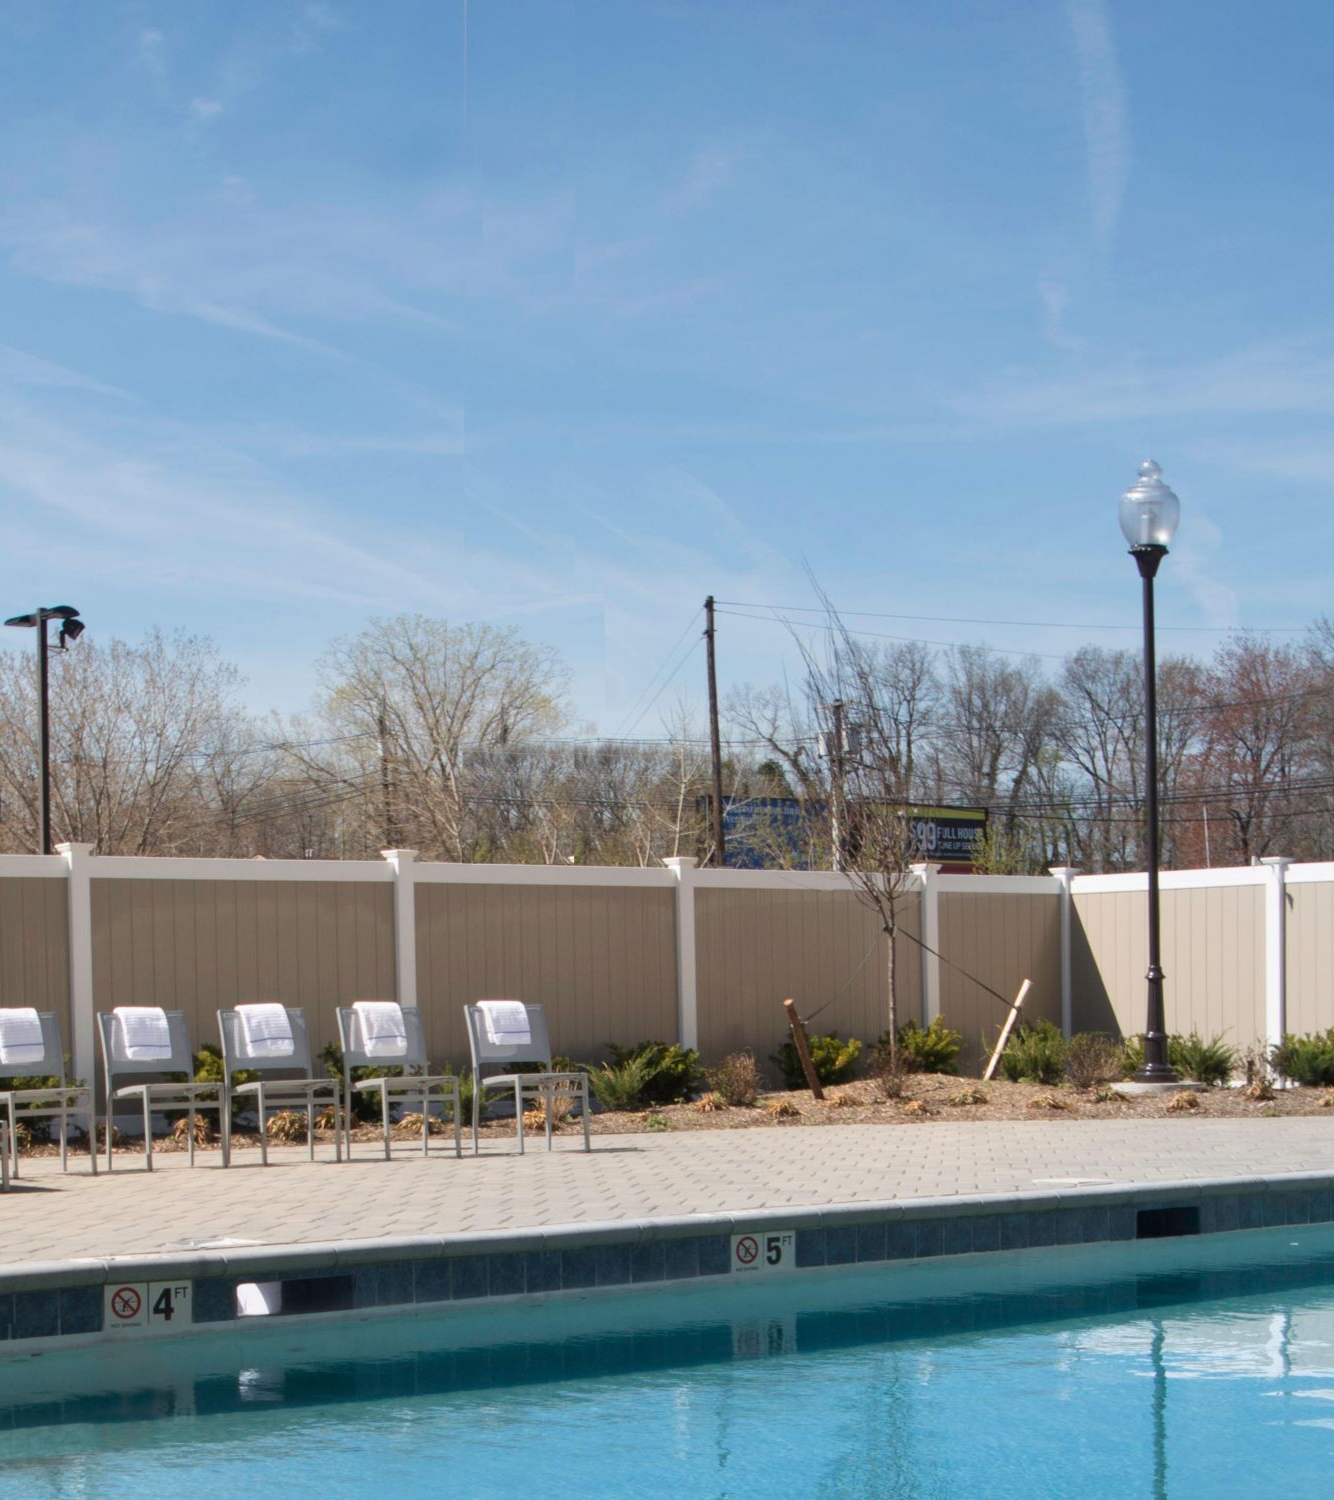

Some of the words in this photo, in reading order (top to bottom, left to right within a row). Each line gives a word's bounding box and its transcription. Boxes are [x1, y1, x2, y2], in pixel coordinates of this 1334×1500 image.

[937, 827, 956, 840] FULL
[766, 1236, 782, 1266] 5
[782, 1235, 793, 1246] FT
[153, 1287, 174, 1321] 4
[175, 1286, 189, 1299] FT
